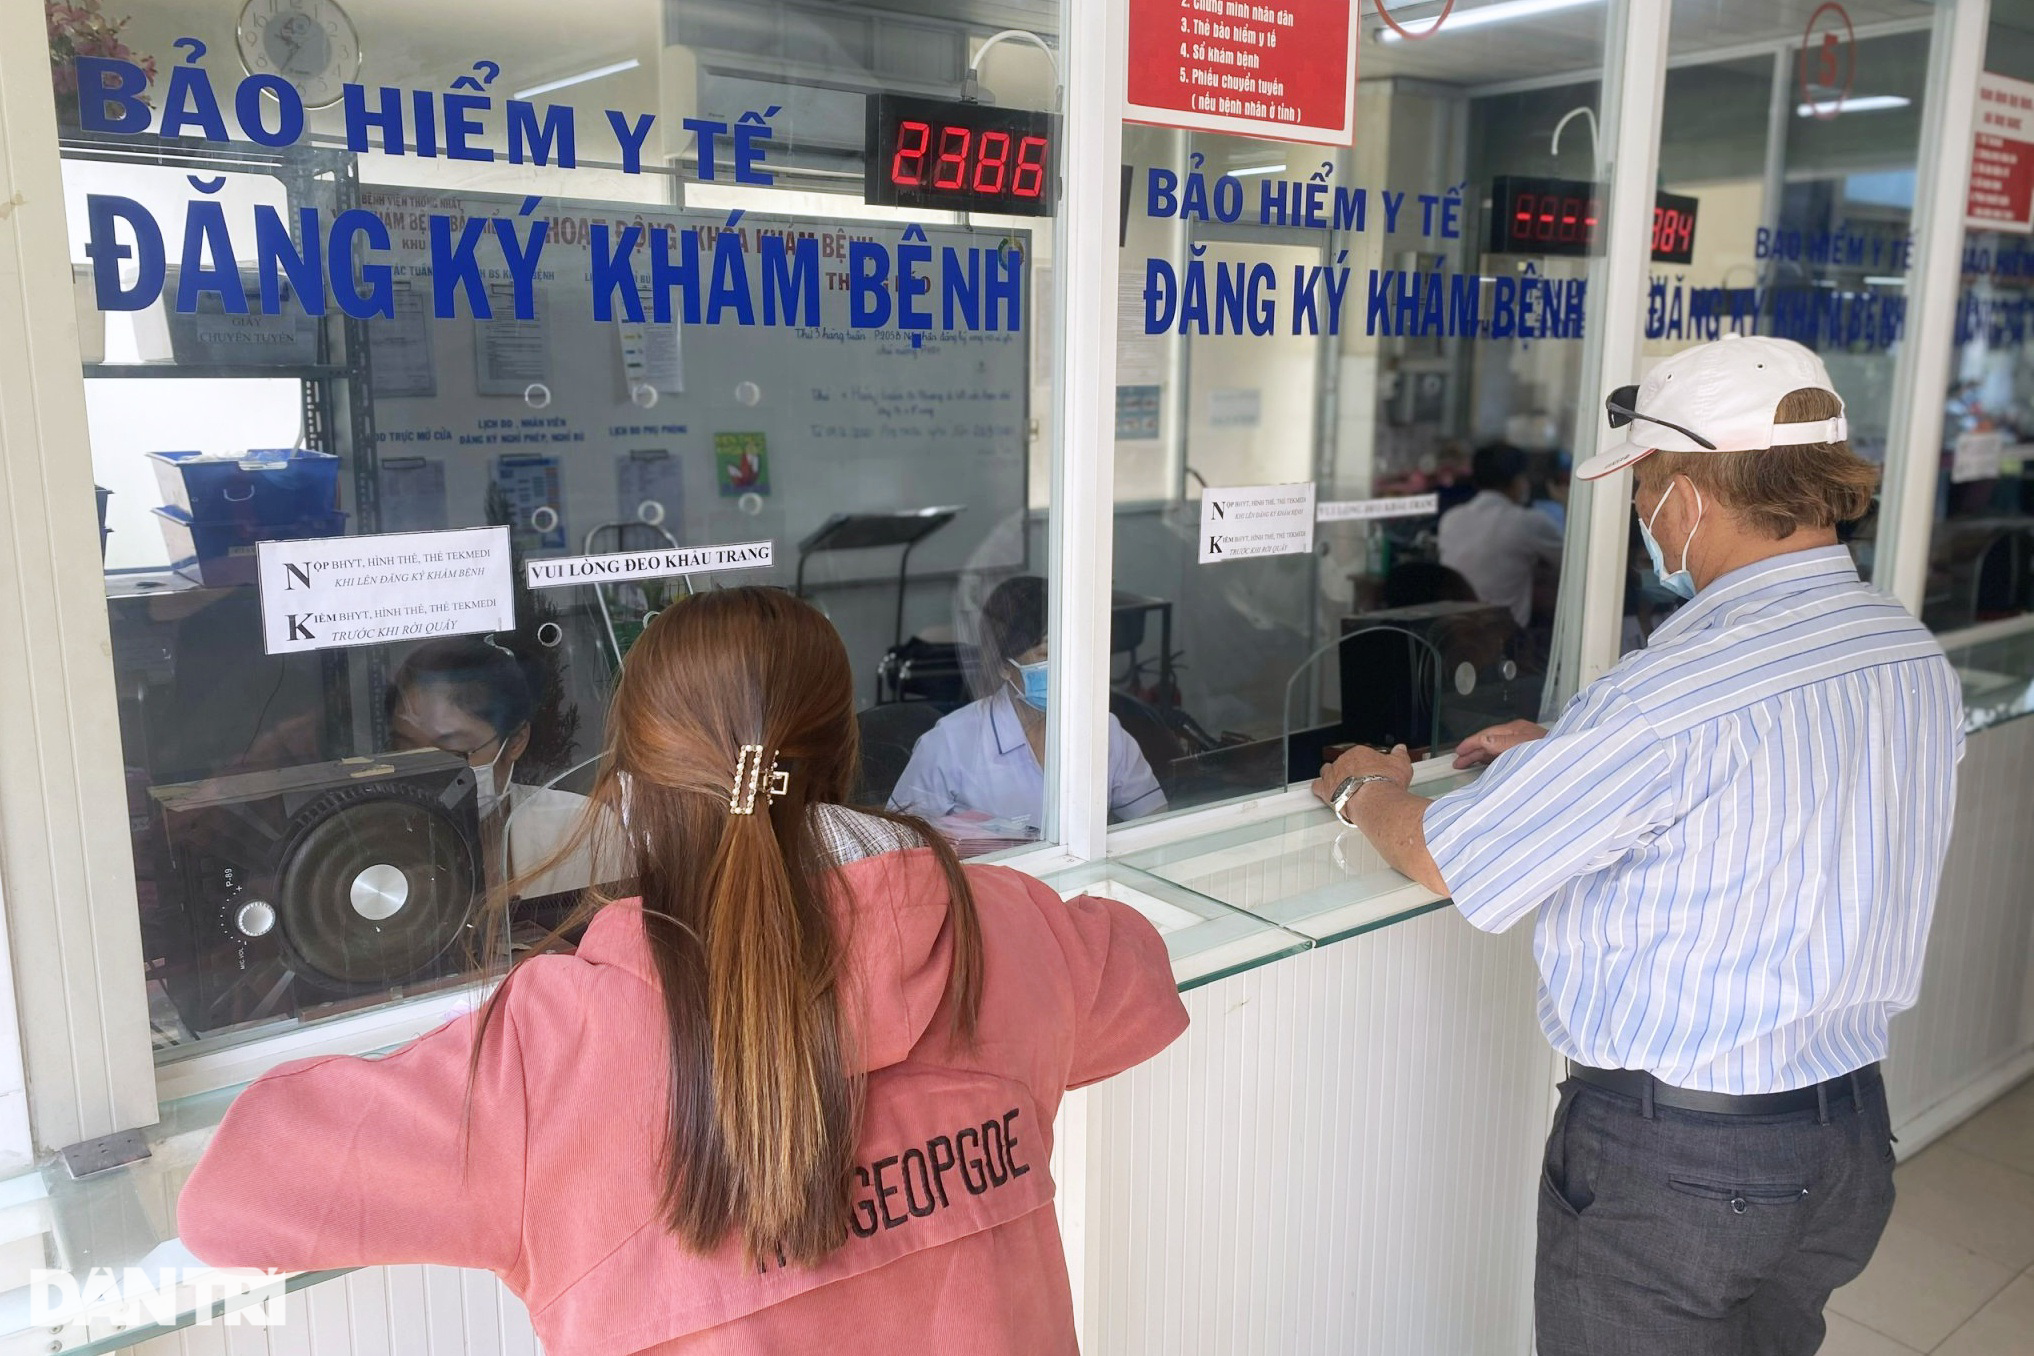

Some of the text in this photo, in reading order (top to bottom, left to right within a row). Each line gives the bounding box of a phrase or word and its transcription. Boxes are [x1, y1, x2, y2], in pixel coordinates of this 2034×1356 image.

[1226, 1, 1249, 19] minh
[1252, 6, 1274, 23] nhân
[1277, 10, 1294, 26] dân
[1180, 17, 1190, 33] 3.
[1193, 18, 1210, 36] Thẻ
[1213, 21, 1230, 40] bảo
[1259, 32, 1265, 47] y
[1267, 29, 1276, 48] tế
[1180, 43, 1190, 58] 4.
[1208, 46, 1234, 65] khám
[1236, 50, 1259, 70] bệnh
[1180, 67, 1189, 83] 5.
[76, 38, 782, 185] BẢO HIỂM Y TẾ
[1219, 97, 1241, 117] bệnh
[1244, 101, 1266, 118] nhân
[892, 121, 1048, 197] 2386
[1148, 153, 1468, 239] BẢO HIỂM Y TẾ
[85, 175, 1021, 348] ĐĂNG KÝ KHÁM BỆNH
[1144, 244, 1588, 350] ĐĂNG KÝ KHÁM BỆNH
[368, 555, 394, 567] HÌNH
[531, 565, 564, 580] VUI
[570, 557, 619, 577] LÒNG
[625, 556, 661, 571] ĐEO
[716, 546, 769, 564] TRANG
[335, 577, 355, 588] KHI
[357, 574, 377, 586] LÊN
[380, 573, 409, 584] ĐĂNG
[375, 607, 401, 618] HÌNH
[332, 627, 375, 641] TRƯỚC
[378, 626, 399, 638] KHI
[402, 621, 422, 634] RỜI
